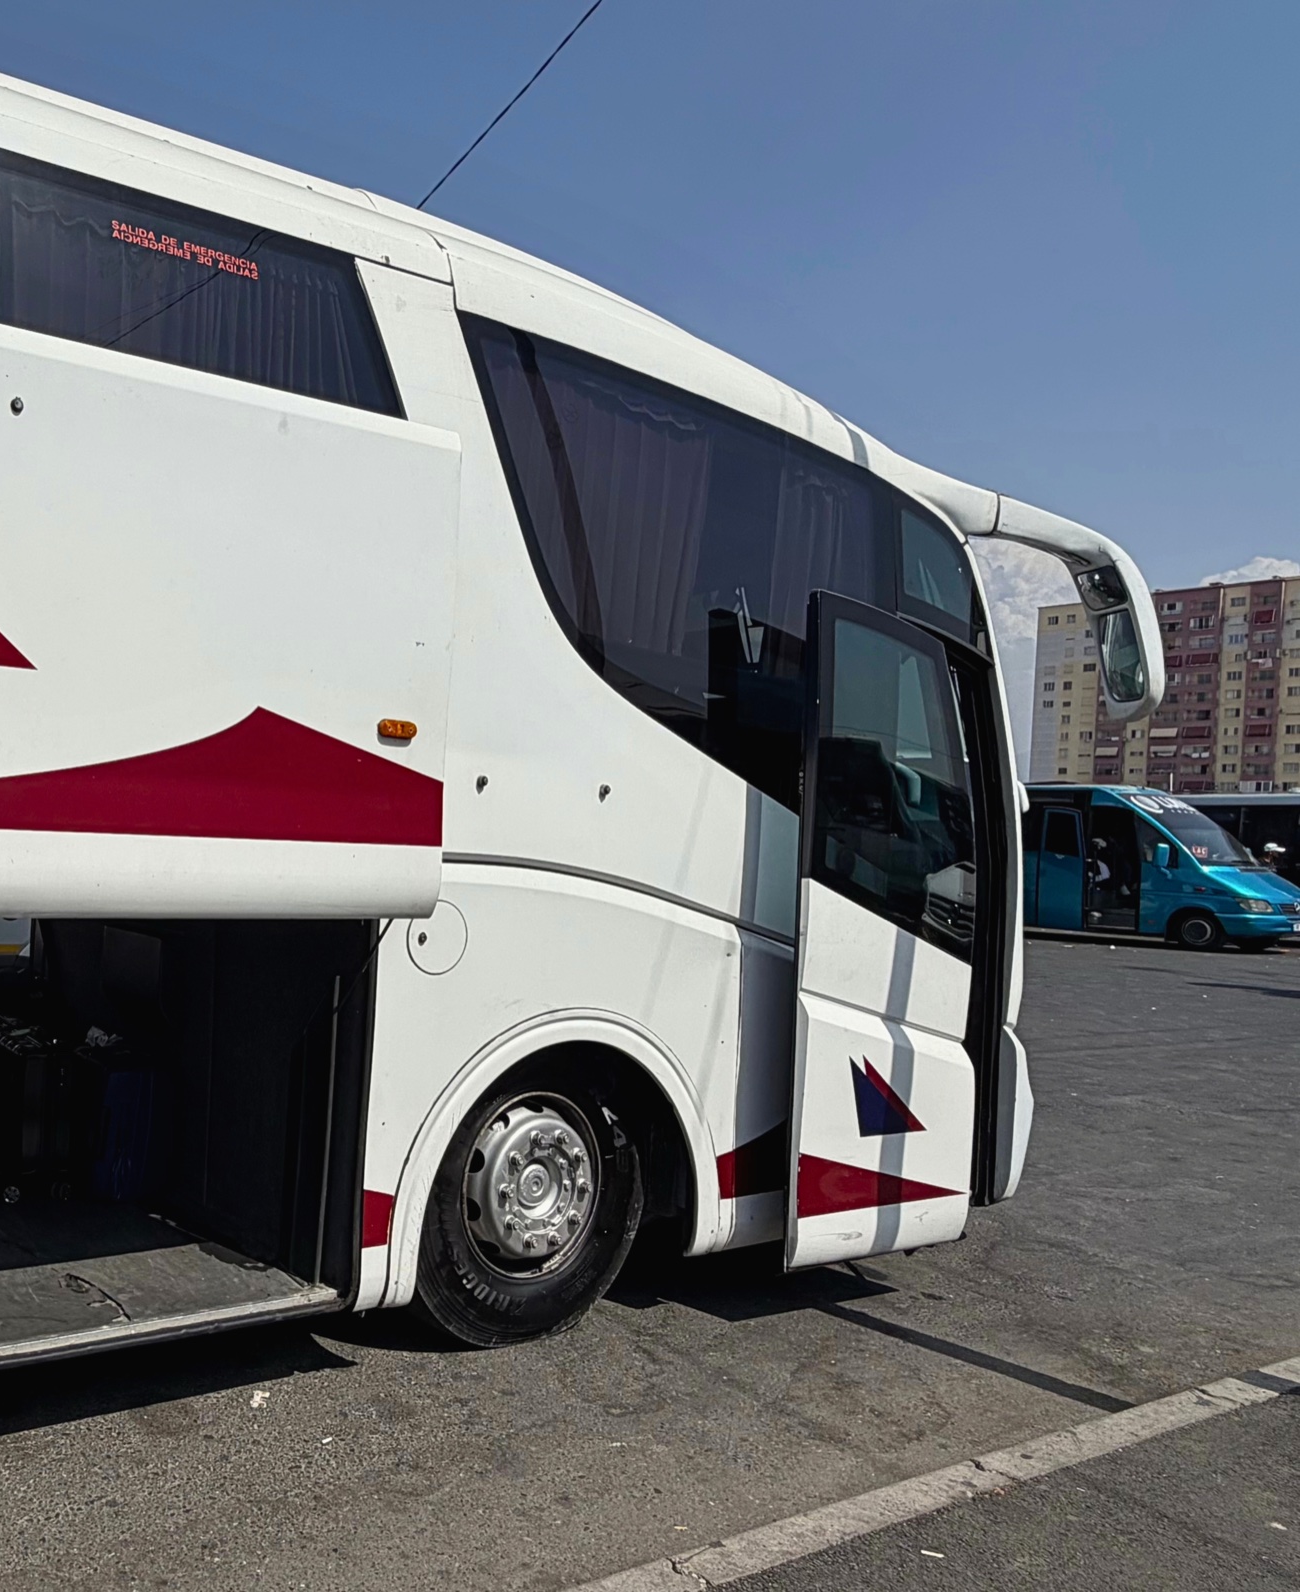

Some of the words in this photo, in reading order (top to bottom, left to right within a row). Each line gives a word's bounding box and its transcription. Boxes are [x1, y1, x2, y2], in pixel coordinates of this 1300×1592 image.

[111, 220, 156, 240] SALIDA
[161, 235, 178, 247] DE
[183, 241, 258, 271] EMERGENCIA
